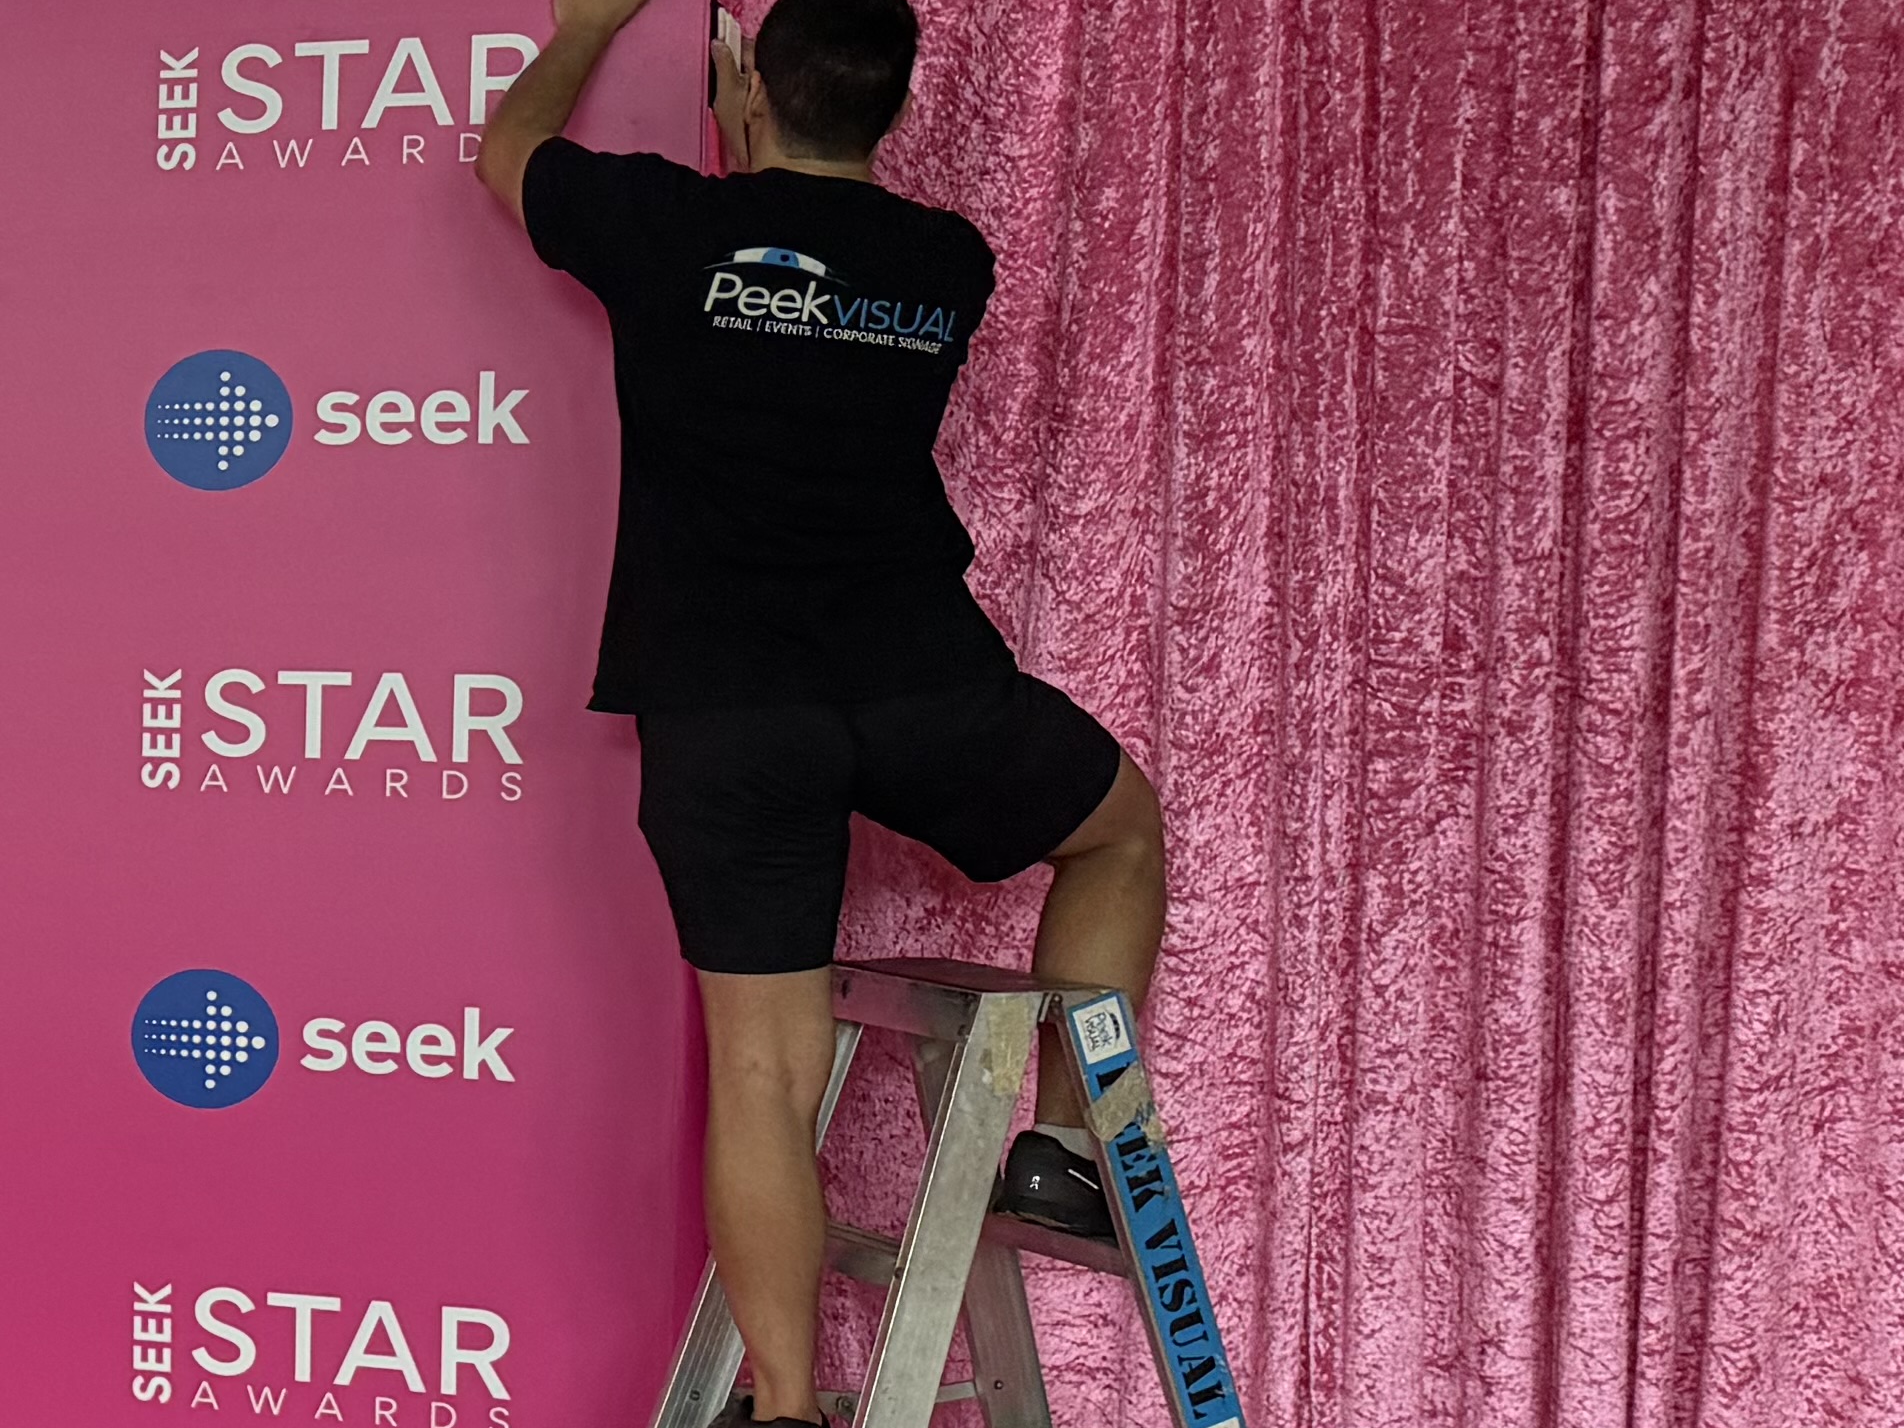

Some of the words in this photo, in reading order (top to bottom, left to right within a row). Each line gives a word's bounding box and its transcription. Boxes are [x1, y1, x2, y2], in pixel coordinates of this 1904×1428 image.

[155, 45, 201, 172] SEEK
[214, 132, 484, 172] AWARD
[711, 315, 753, 332] RETAIL
[764, 320, 813, 337] EVENTS
[823, 327, 897, 348] CORPORATE
[312, 369, 532, 447] seek
[139, 667, 183, 791] SEEK
[199, 667, 525, 766] STAR
[199, 762, 523, 803] AWARDS
[299, 1005, 517, 1084] seek
[130, 1280, 174, 1405] SEEK
[190, 1285, 513, 1402] STAR
[1144, 1217, 1226, 1421] VISUAL
